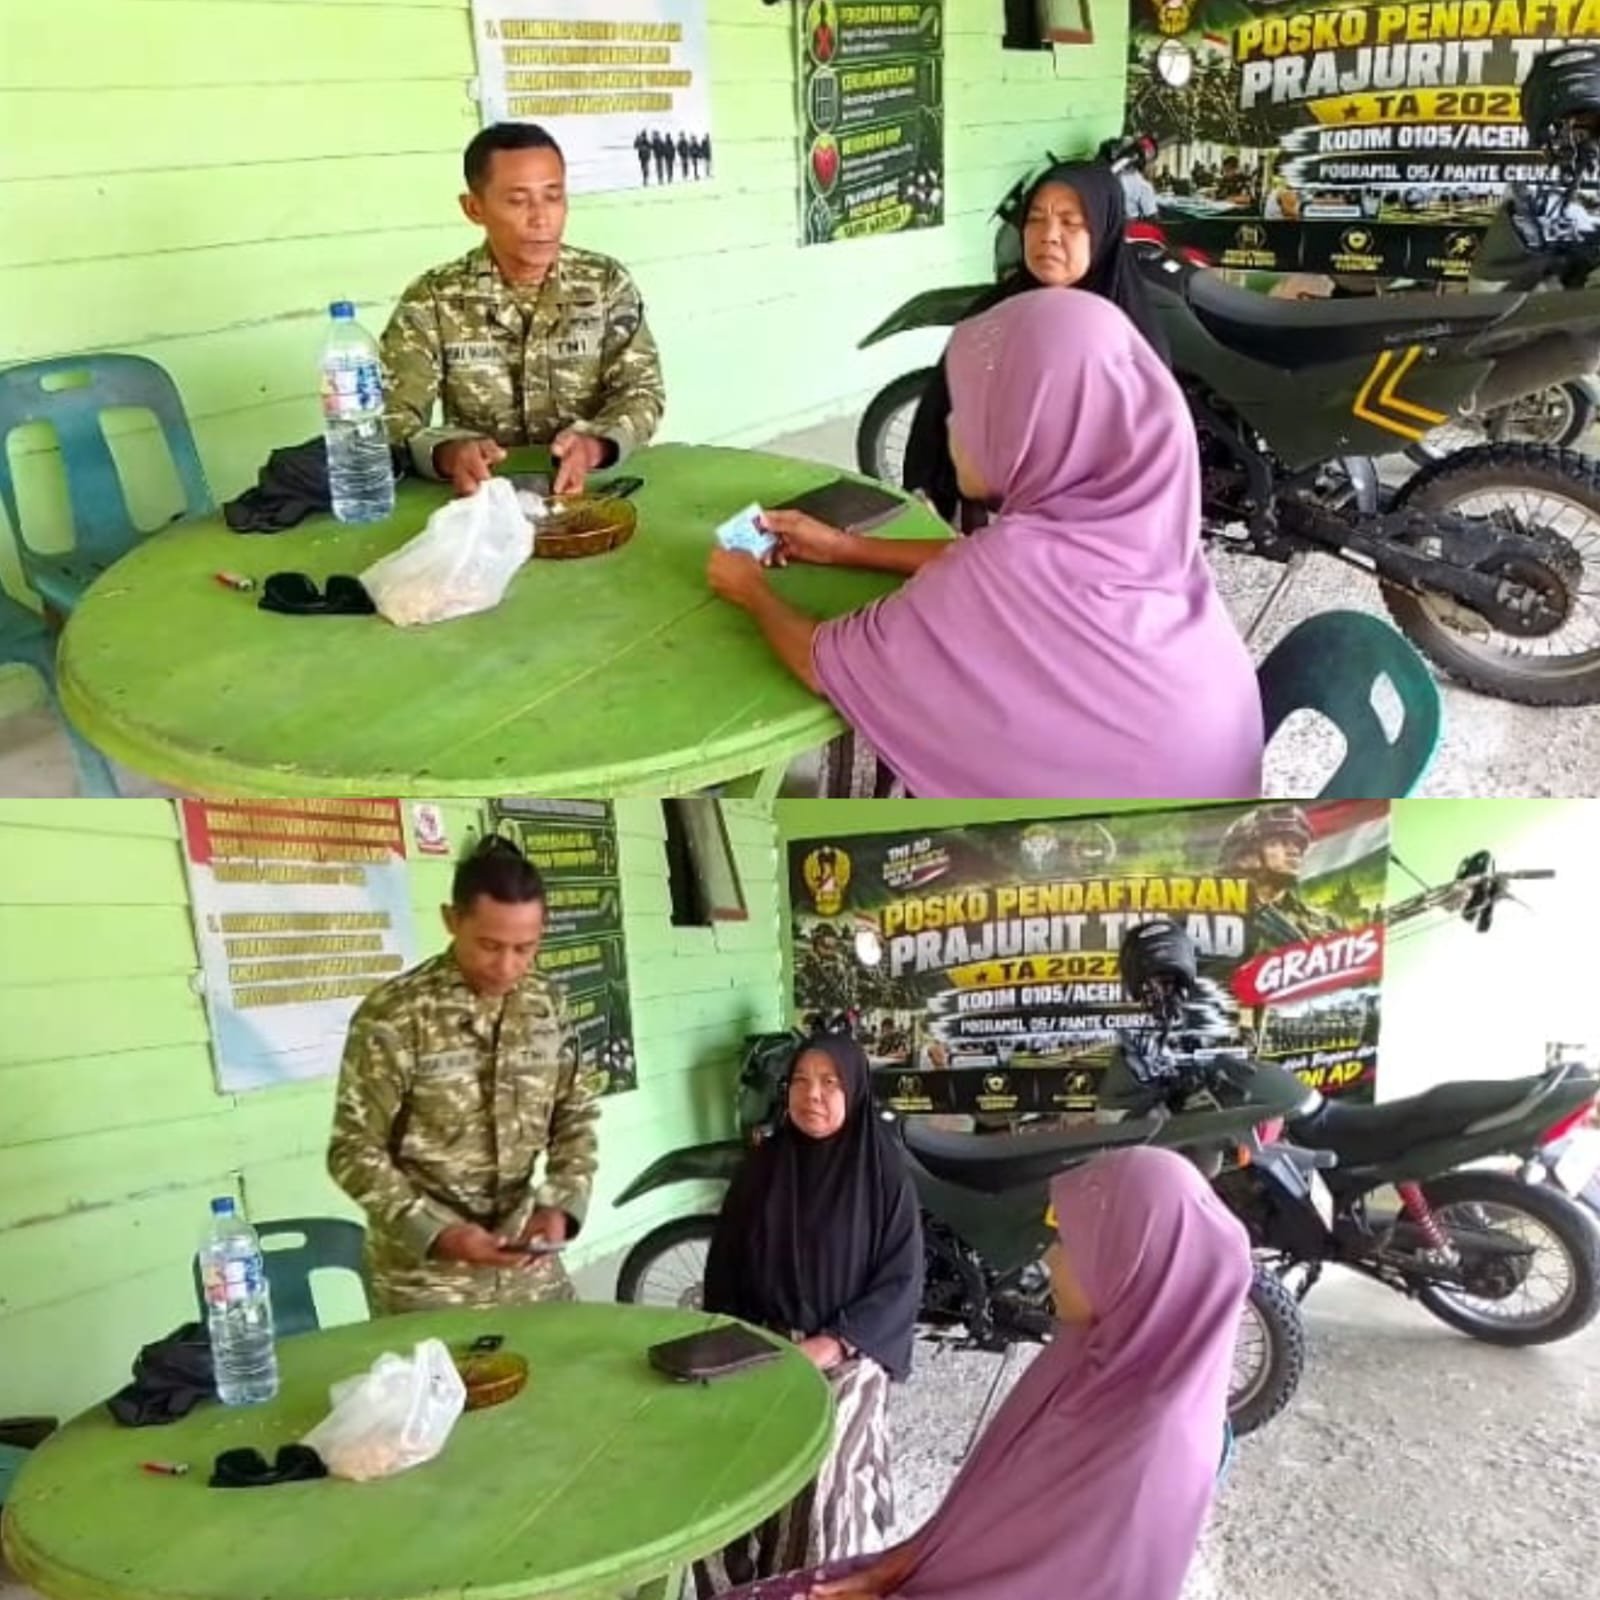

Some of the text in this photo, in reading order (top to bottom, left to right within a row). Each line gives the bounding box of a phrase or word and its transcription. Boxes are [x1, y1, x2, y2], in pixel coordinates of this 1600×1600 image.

[1238, 9, 1367, 60] POSKO
[1241, 40, 1494, 109] PRAJURIT
[1374, 91, 1521, 117] TA 202
[1320, 124, 1530, 152] KODIM 0105/ACEH
[1443, 163, 1501, 180] PANTE
[884, 878, 1249, 937] POSKO PENDAFTARAN
[891, 914, 1087, 978] PRAJURIT
[1186, 914, 1243, 957] AD
[1001, 961, 1037, 981] TA
[1254, 929, 1379, 994] GRATIS
[959, 983, 1121, 1011] KODIM 0105/ACEH
[1328, 1061, 1363, 1088] AD
